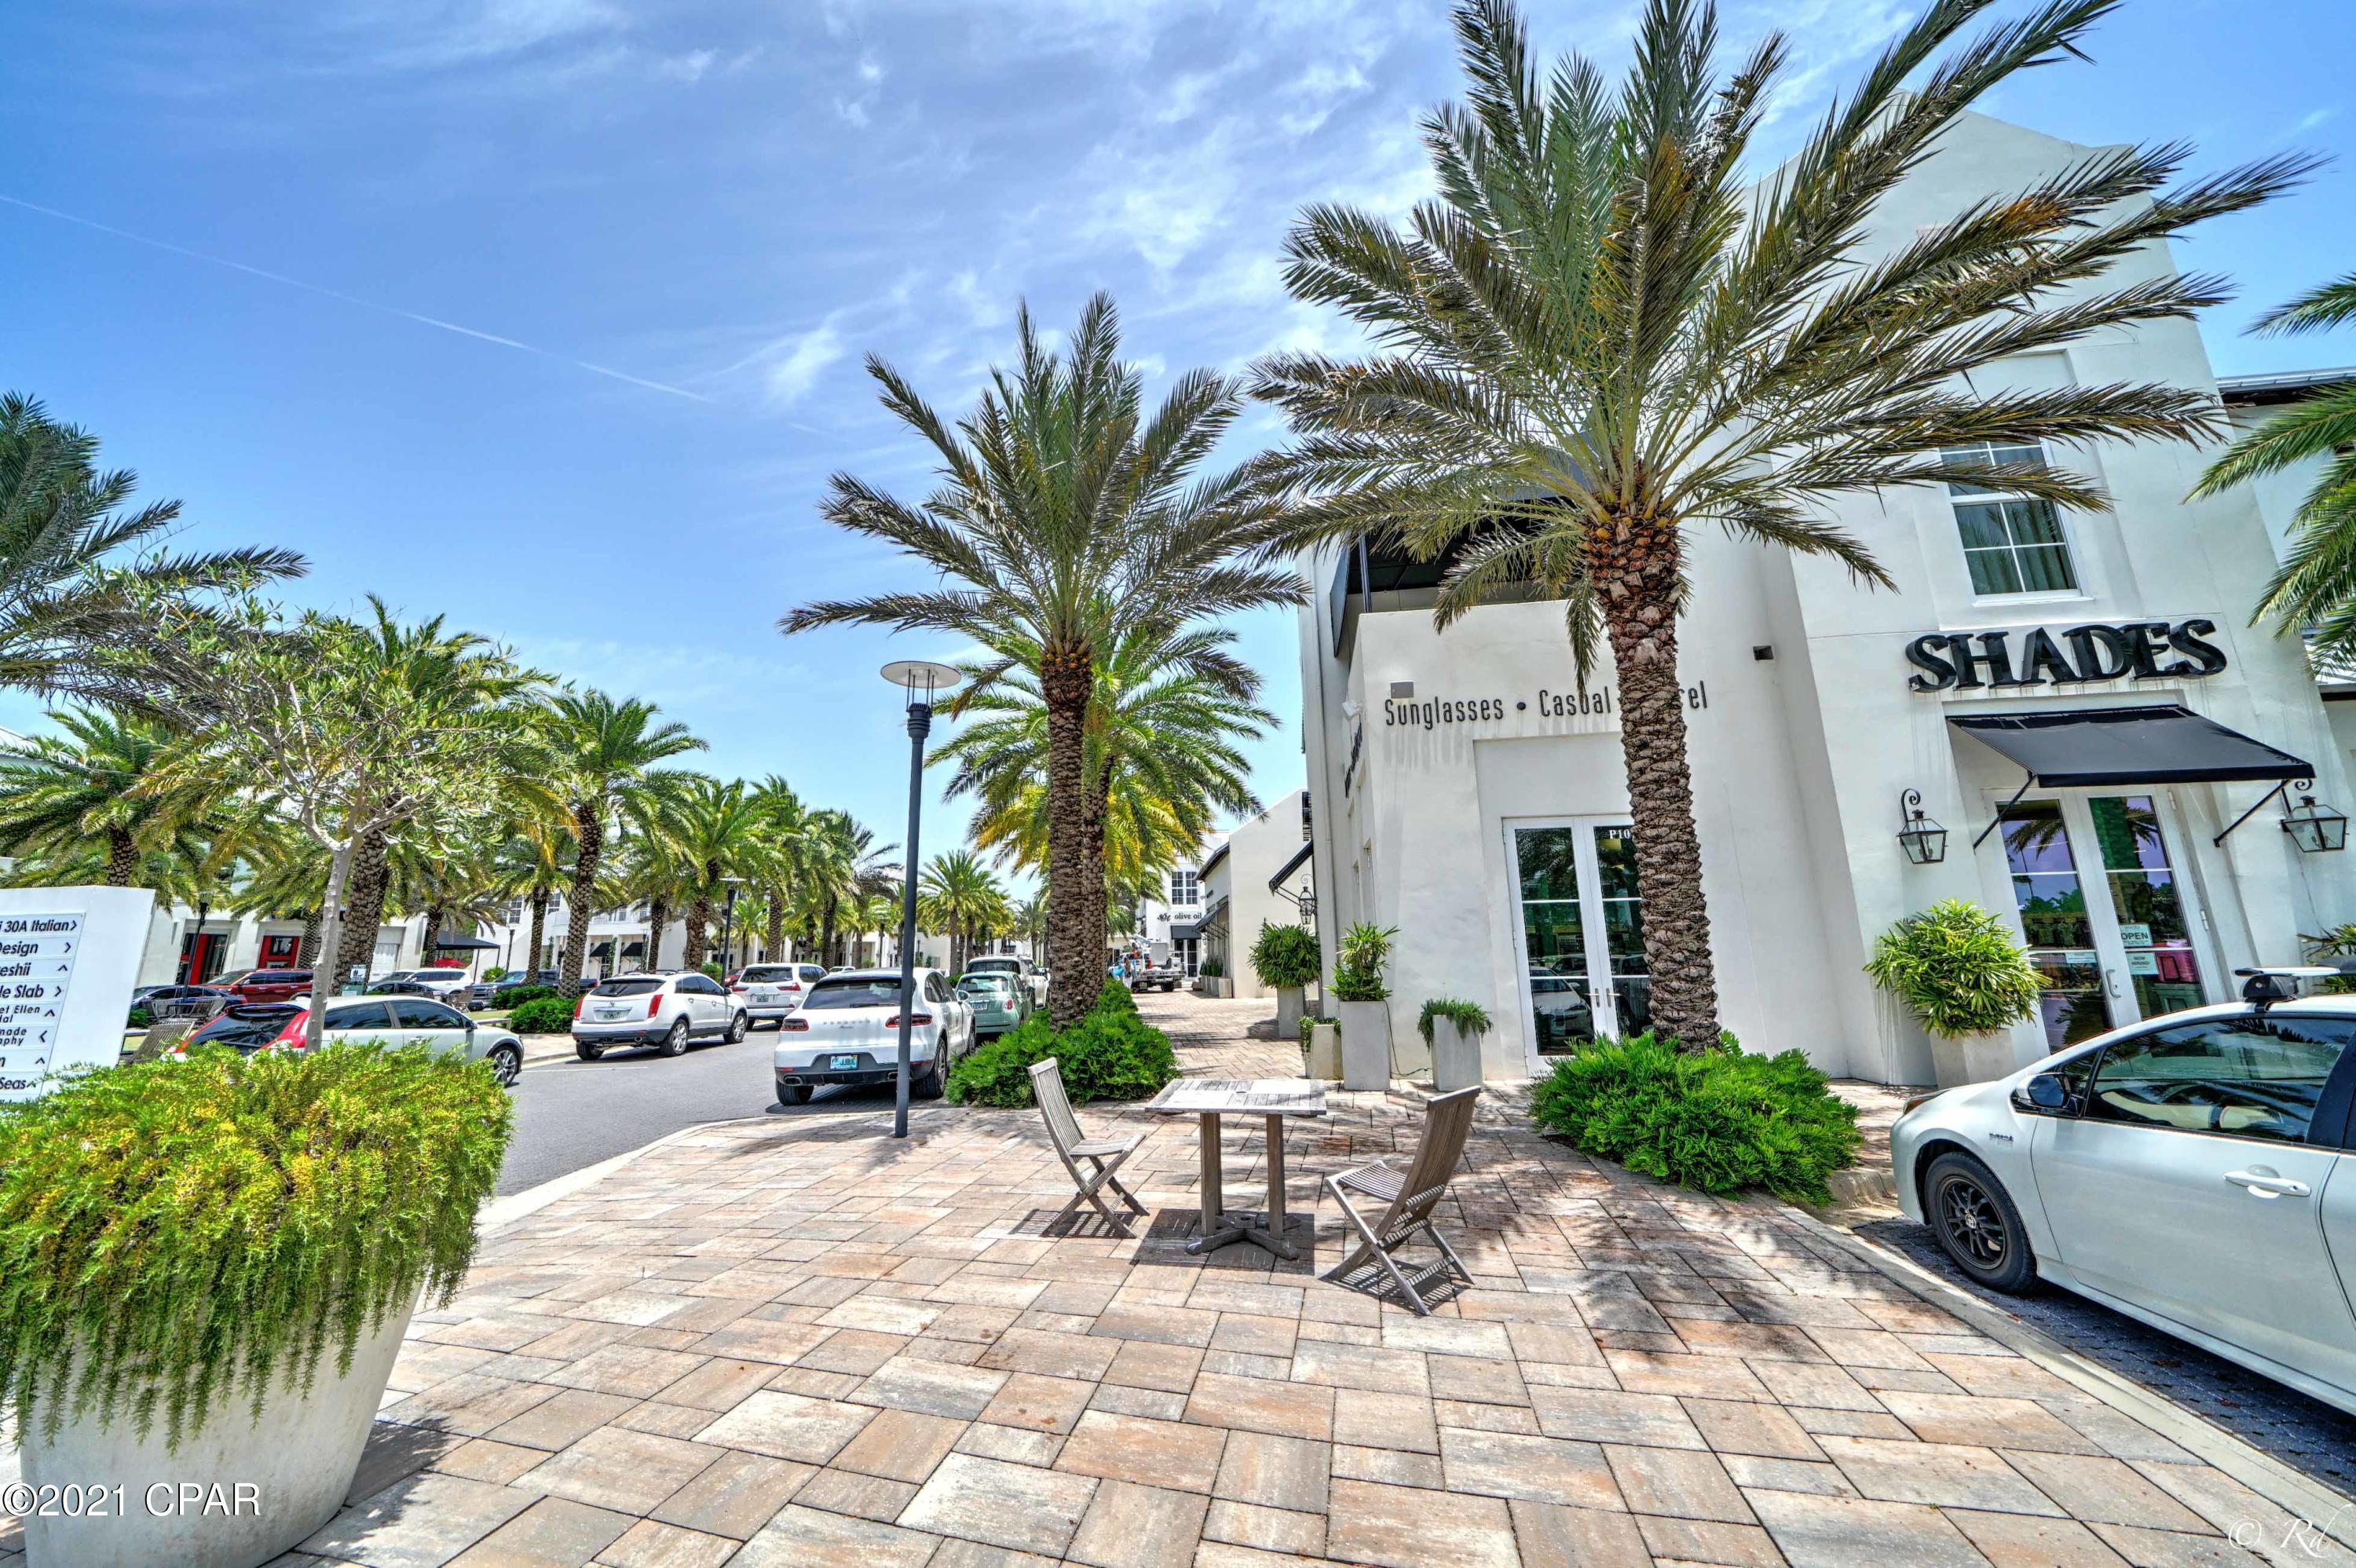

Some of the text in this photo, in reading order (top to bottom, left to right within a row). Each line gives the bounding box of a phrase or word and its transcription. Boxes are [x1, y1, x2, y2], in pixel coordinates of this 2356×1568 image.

[1905, 619, 2227, 693] SHADES
[1385, 686, 1612, 731] Sunglasses Casual
[1609, 828, 1631, 839] P10
[4, 920, 27, 933] 30A
[31, 919, 69, 932] Italian
[0, 962, 31, 977] eshii
[14, 984, 44, 999] Slab
[14, 1005, 40, 1014] Ellen
